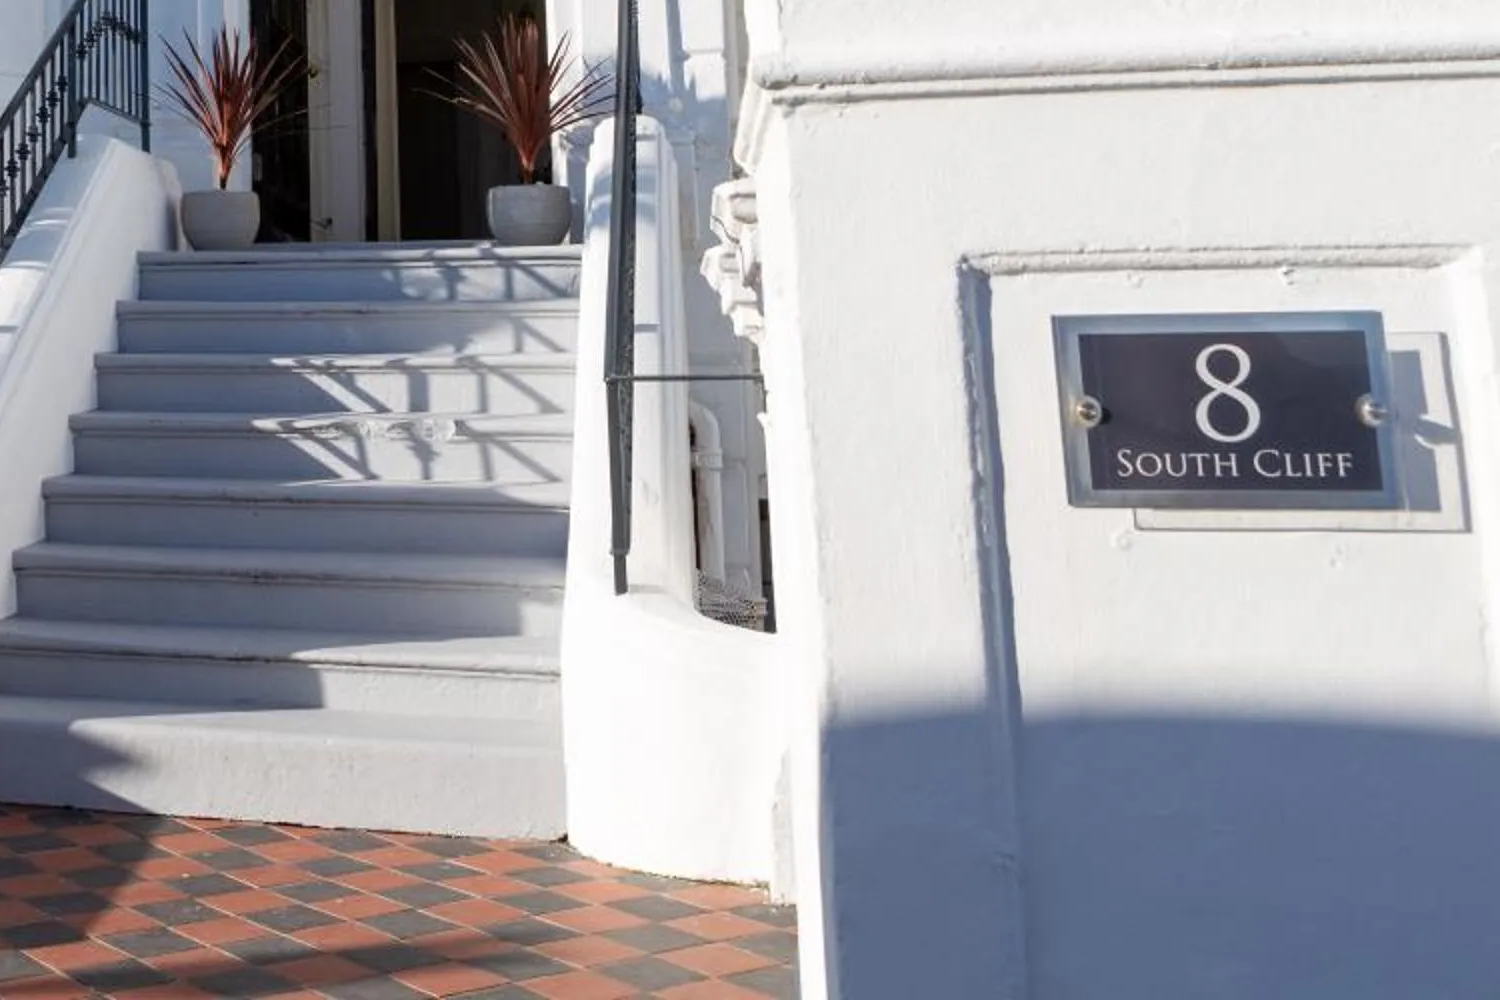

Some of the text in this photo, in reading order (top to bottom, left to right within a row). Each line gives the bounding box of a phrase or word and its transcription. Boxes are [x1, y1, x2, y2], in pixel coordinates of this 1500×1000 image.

[1195, 343, 1261, 443] 8
[1117, 449, 1353, 478] SOUTH CLIFF
